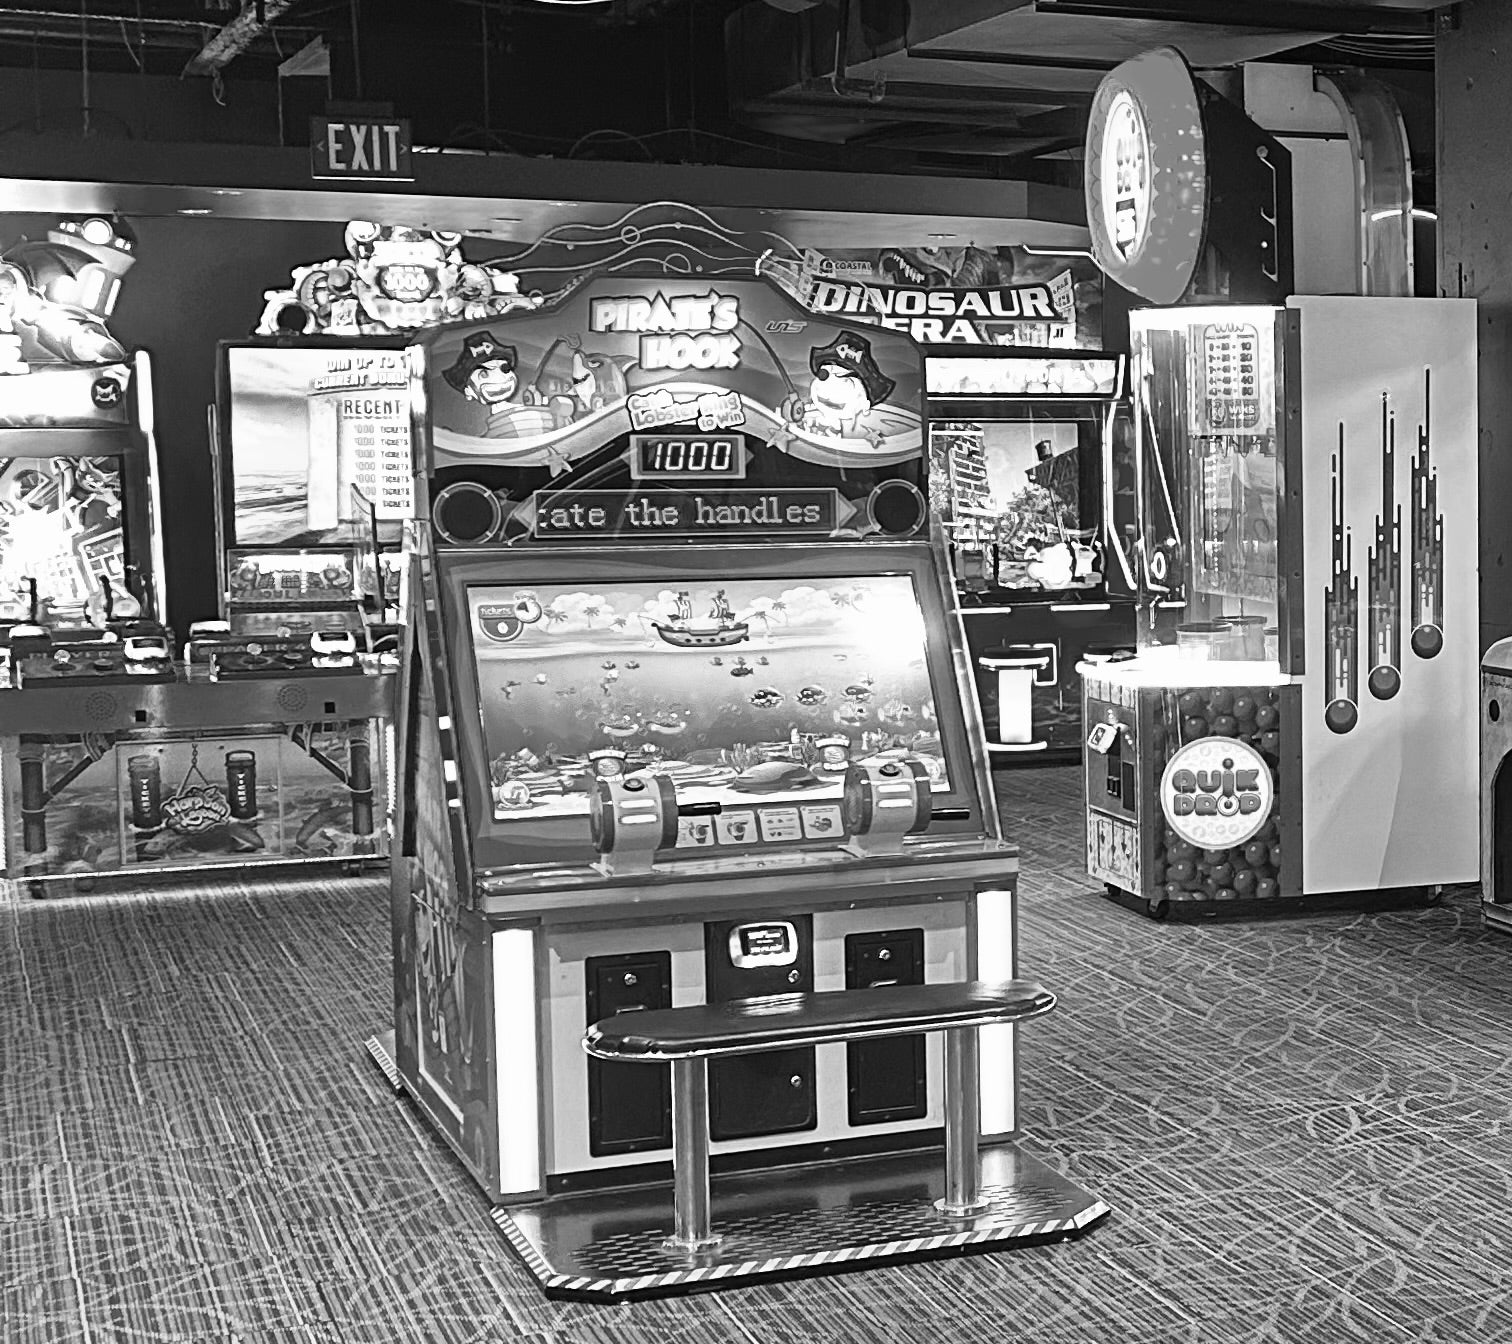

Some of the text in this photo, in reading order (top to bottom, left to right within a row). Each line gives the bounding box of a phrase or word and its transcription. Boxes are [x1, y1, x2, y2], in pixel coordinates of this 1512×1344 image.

[328, 123, 400, 172] EXIT
[589, 288, 740, 333] PIRATE'S
[814, 280, 1055, 318] DINOSAUR
[640, 331, 743, 370] HOOK
[343, 400, 401, 415] RECENT
[654, 441, 732, 471] 1000
[625, 498, 679, 526] the
[694, 496, 820, 524] handles
[1173, 793, 1262, 817] DROP
